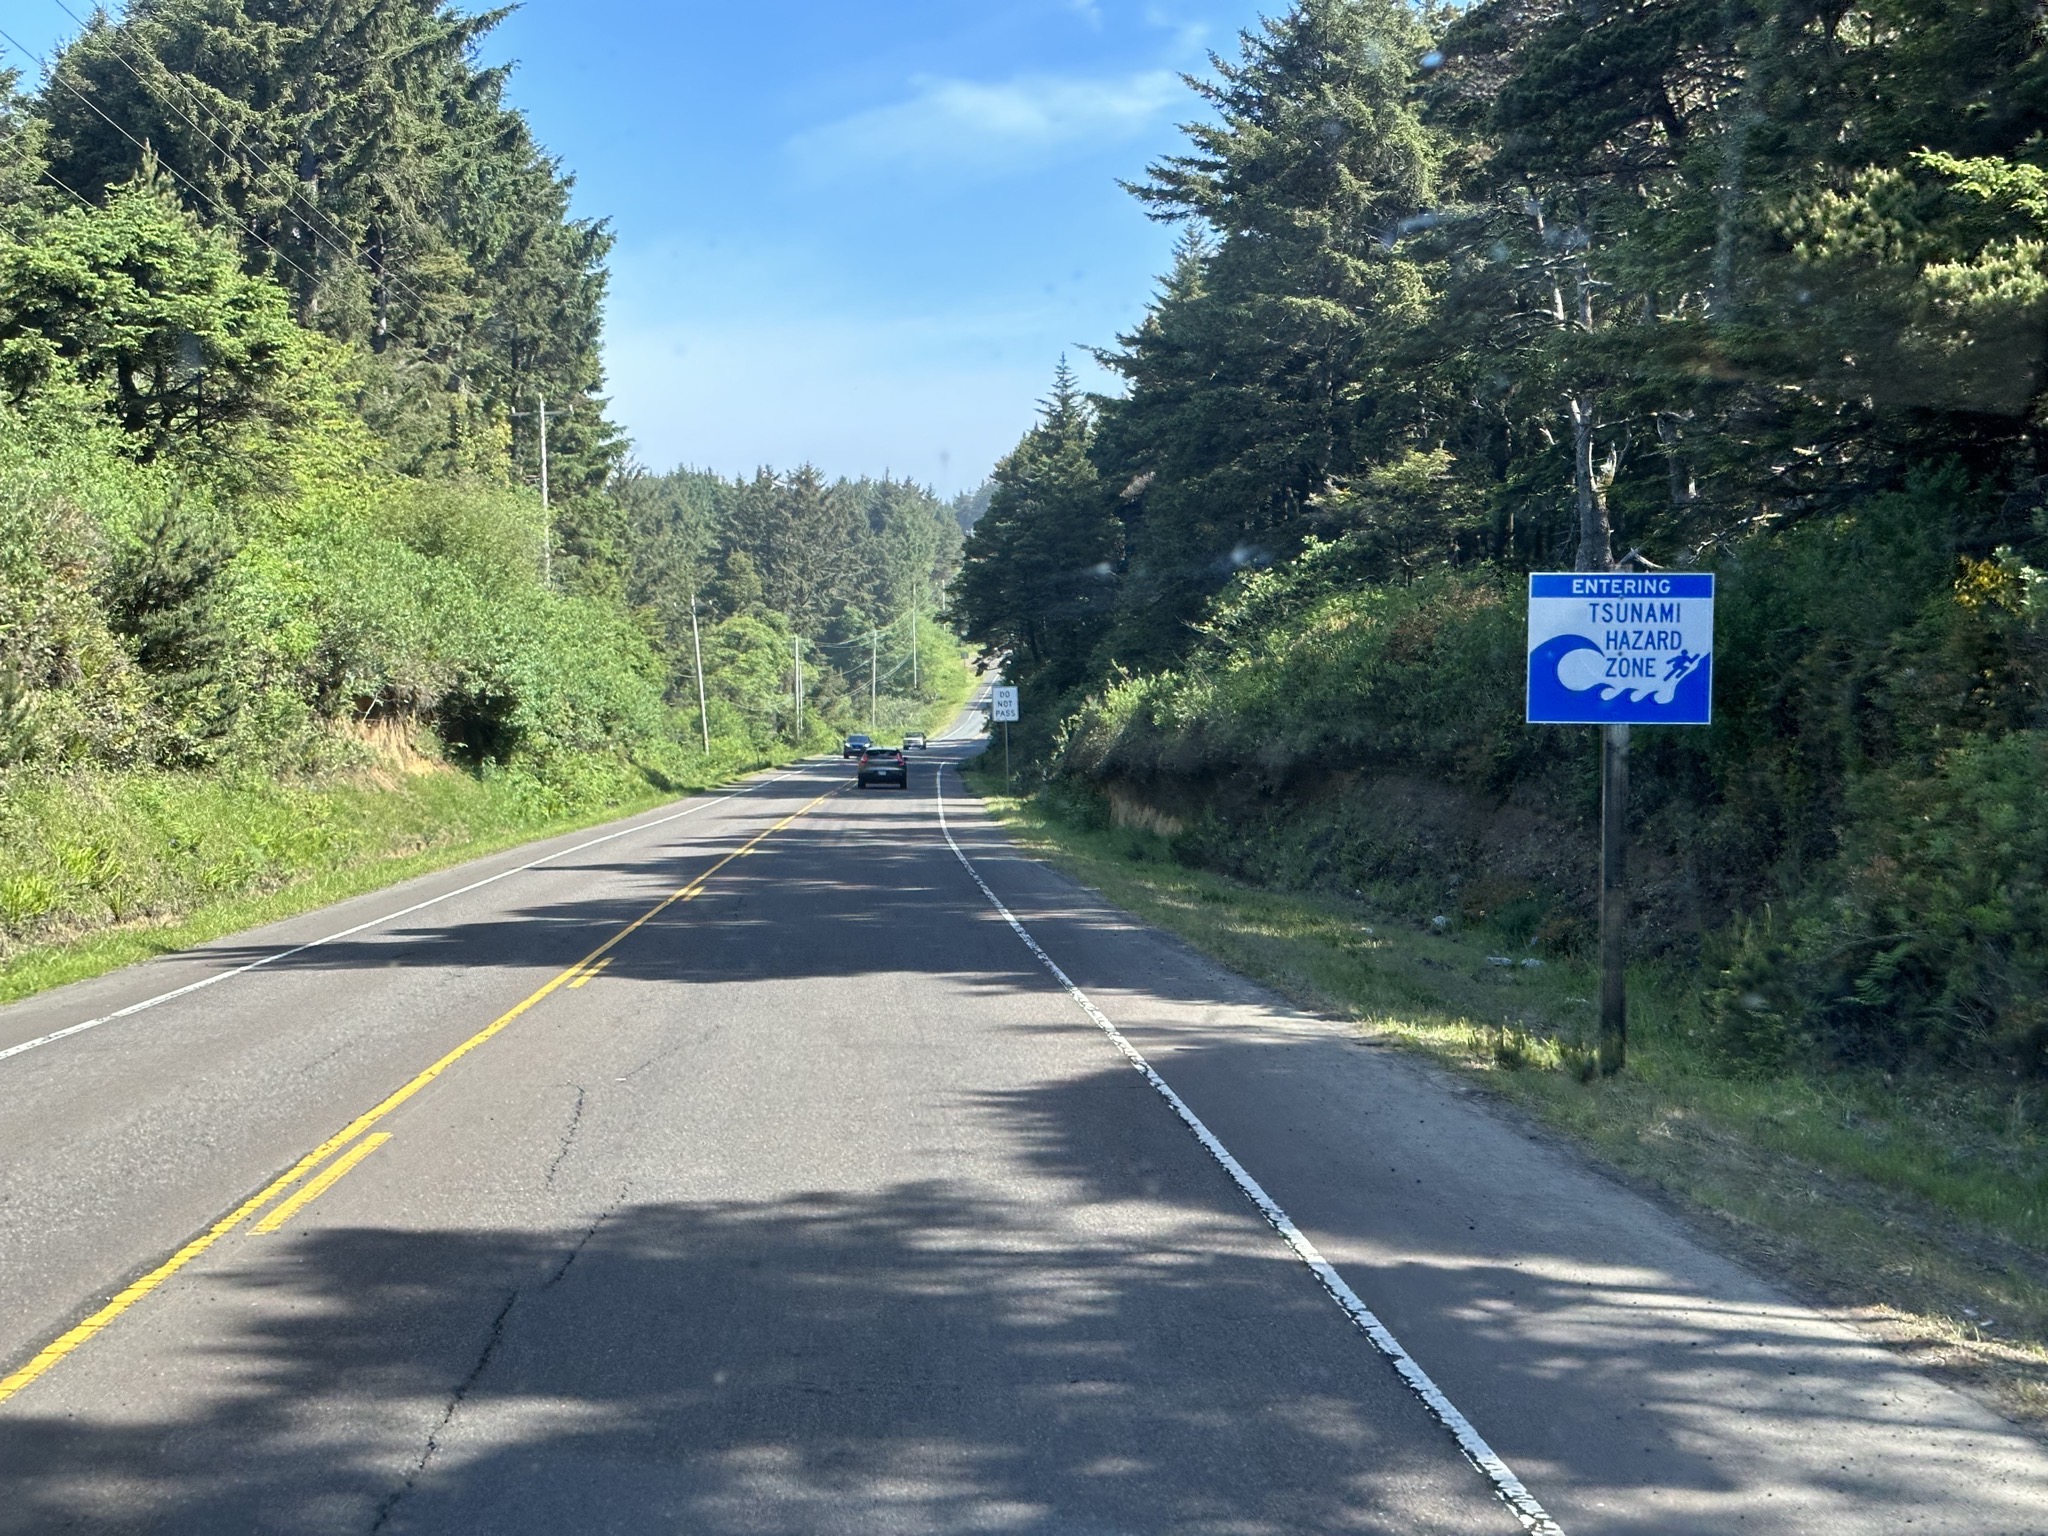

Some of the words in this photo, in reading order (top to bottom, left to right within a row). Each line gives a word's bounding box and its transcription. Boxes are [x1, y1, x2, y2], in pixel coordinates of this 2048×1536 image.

[1572, 579, 1671, 594] ENTERING
[1589, 603, 1681, 623] TSUNAMI
[1605, 630, 1682, 650] HAZARD
[1605, 657, 1656, 678] ZONE
[999, 690, 1010, 698] DO
[997, 700, 1012, 708] NOT
